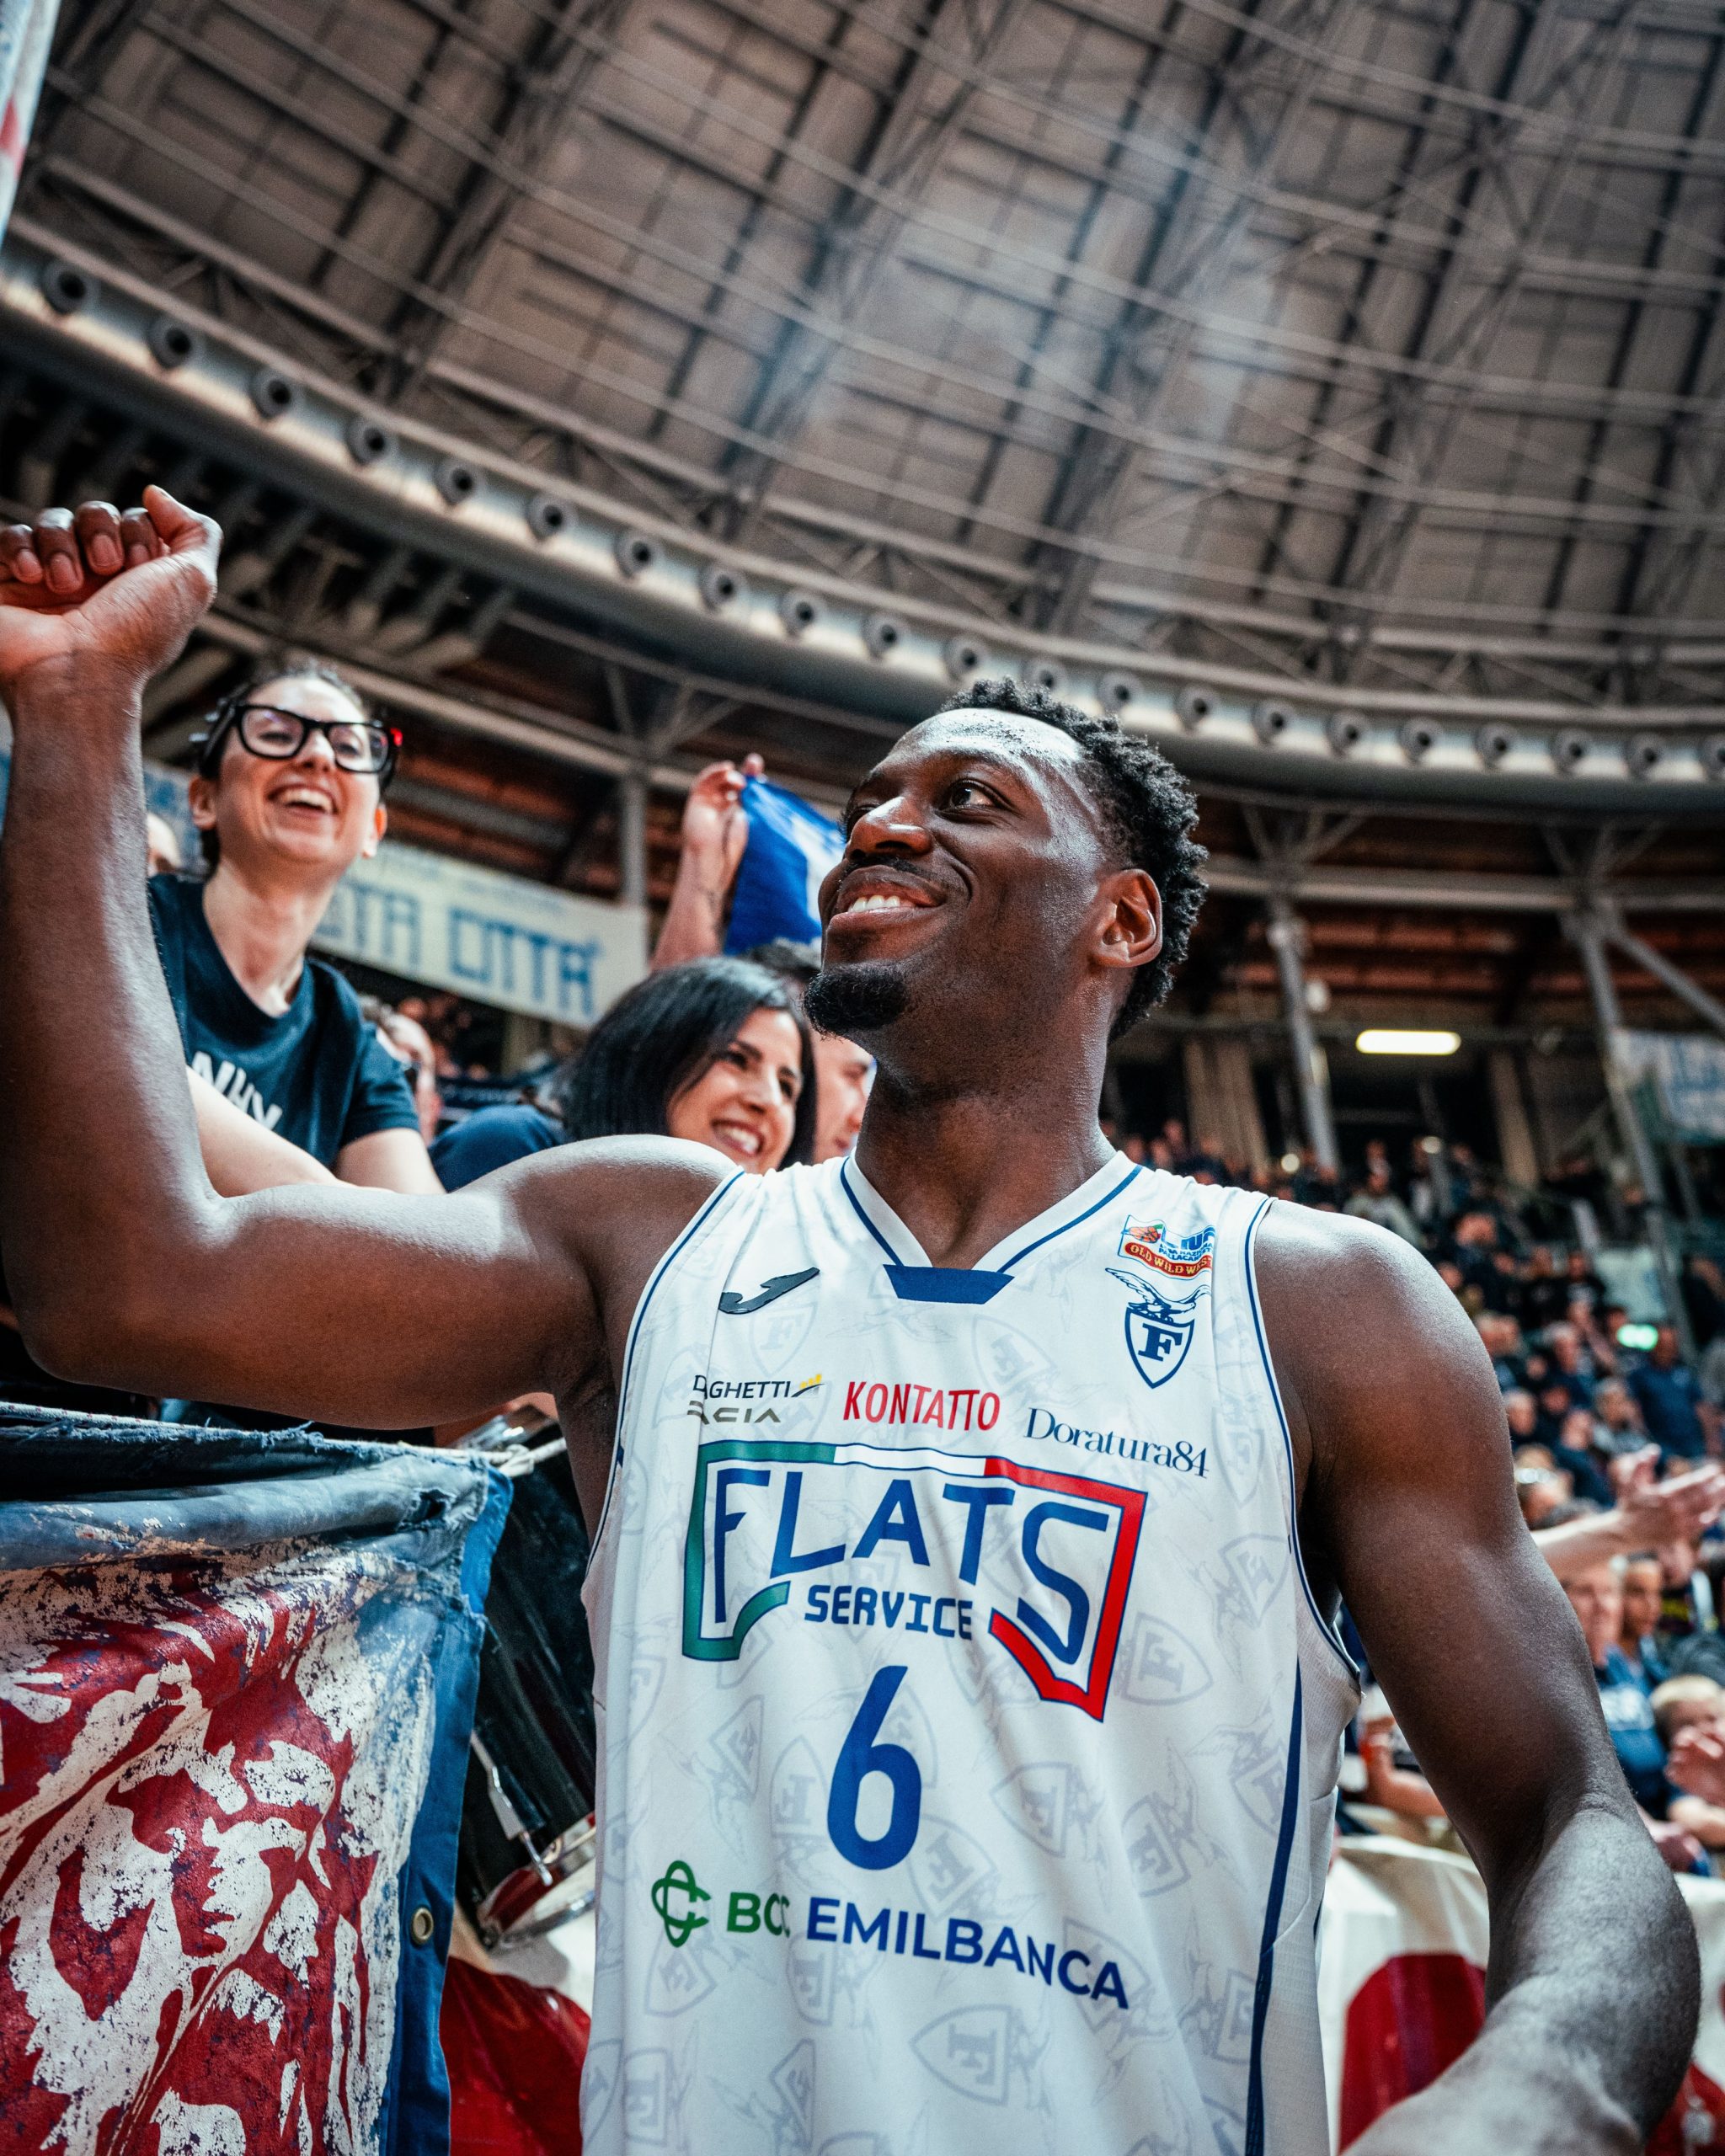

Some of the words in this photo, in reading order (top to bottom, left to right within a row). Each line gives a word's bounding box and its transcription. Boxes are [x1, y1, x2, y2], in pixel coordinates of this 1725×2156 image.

[1130, 1244, 1152, 1262] OLD
[1154, 1256, 1183, 1273] WILD
[1137, 1322, 1184, 1363] F
[843, 1381, 1001, 1432] KONTATTO
[1023, 1407, 1210, 1479] Doratura84
[714, 1469, 1111, 1666] FLATS
[804, 1584, 975, 1641] SERVICE
[827, 1665, 922, 1870] 6
[807, 1897, 1129, 2009] EMILBANCA
